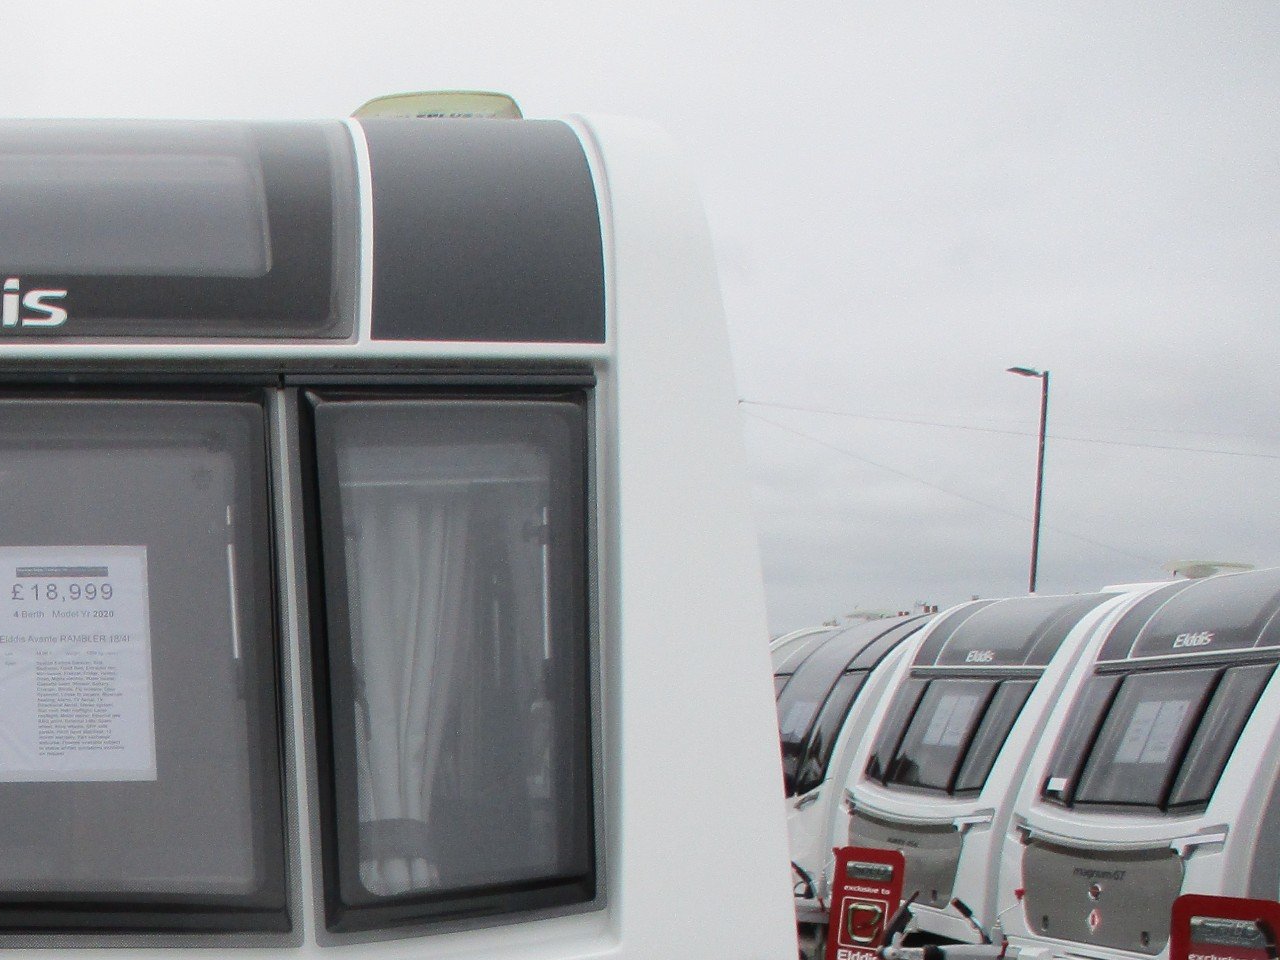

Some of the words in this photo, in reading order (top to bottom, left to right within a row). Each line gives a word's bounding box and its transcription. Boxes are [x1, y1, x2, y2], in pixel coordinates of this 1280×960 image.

[11, 583, 114, 602] £18,999
[93, 610, 114, 618] 2020
[59, 635, 106, 643] RAMBLER
[843, 884, 879, 894] exclusive
[881, 887, 891, 895] to
